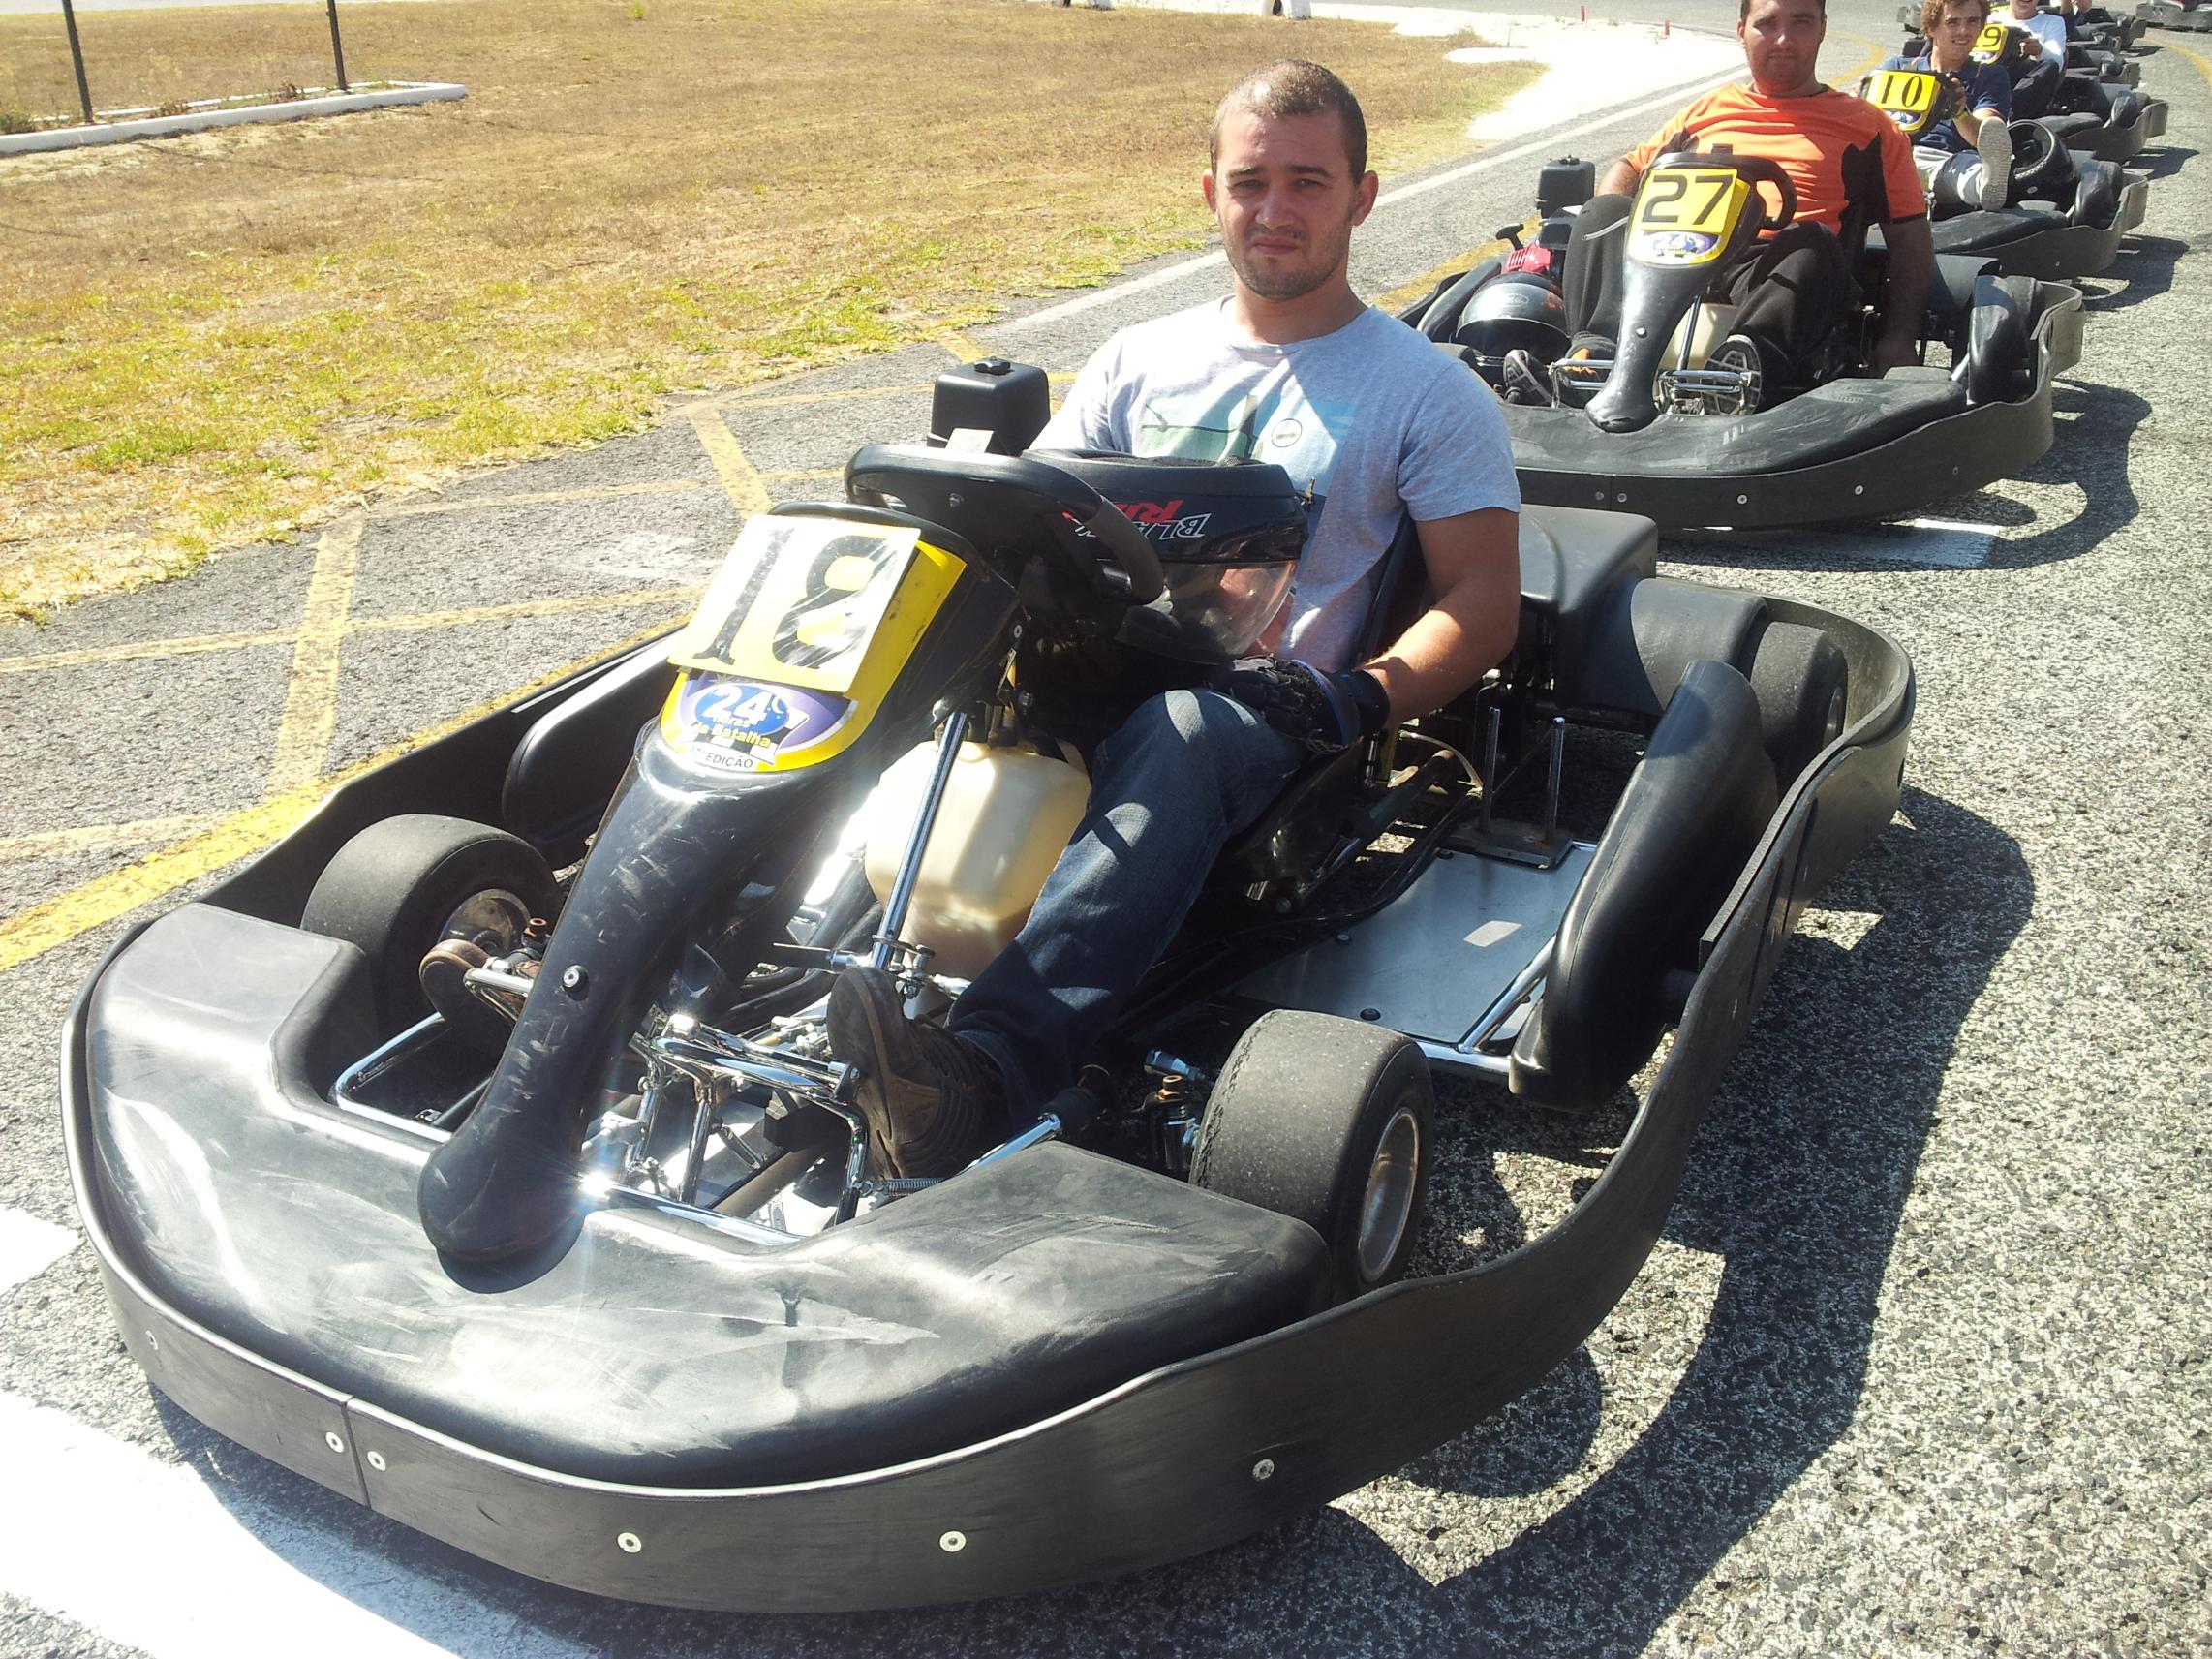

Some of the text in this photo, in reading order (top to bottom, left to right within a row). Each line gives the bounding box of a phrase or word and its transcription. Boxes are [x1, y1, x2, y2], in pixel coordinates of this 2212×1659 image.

[1975, 26, 2002, 48] 9
[1881, 75, 1923, 108] 10
[1641, 174, 1734, 226] 27
[692, 528, 899, 670] 18
[701, 684, 773, 724] 24
[712, 724, 771, 748] Batalha
[706, 753, 753, 769] EDIÇÃO
